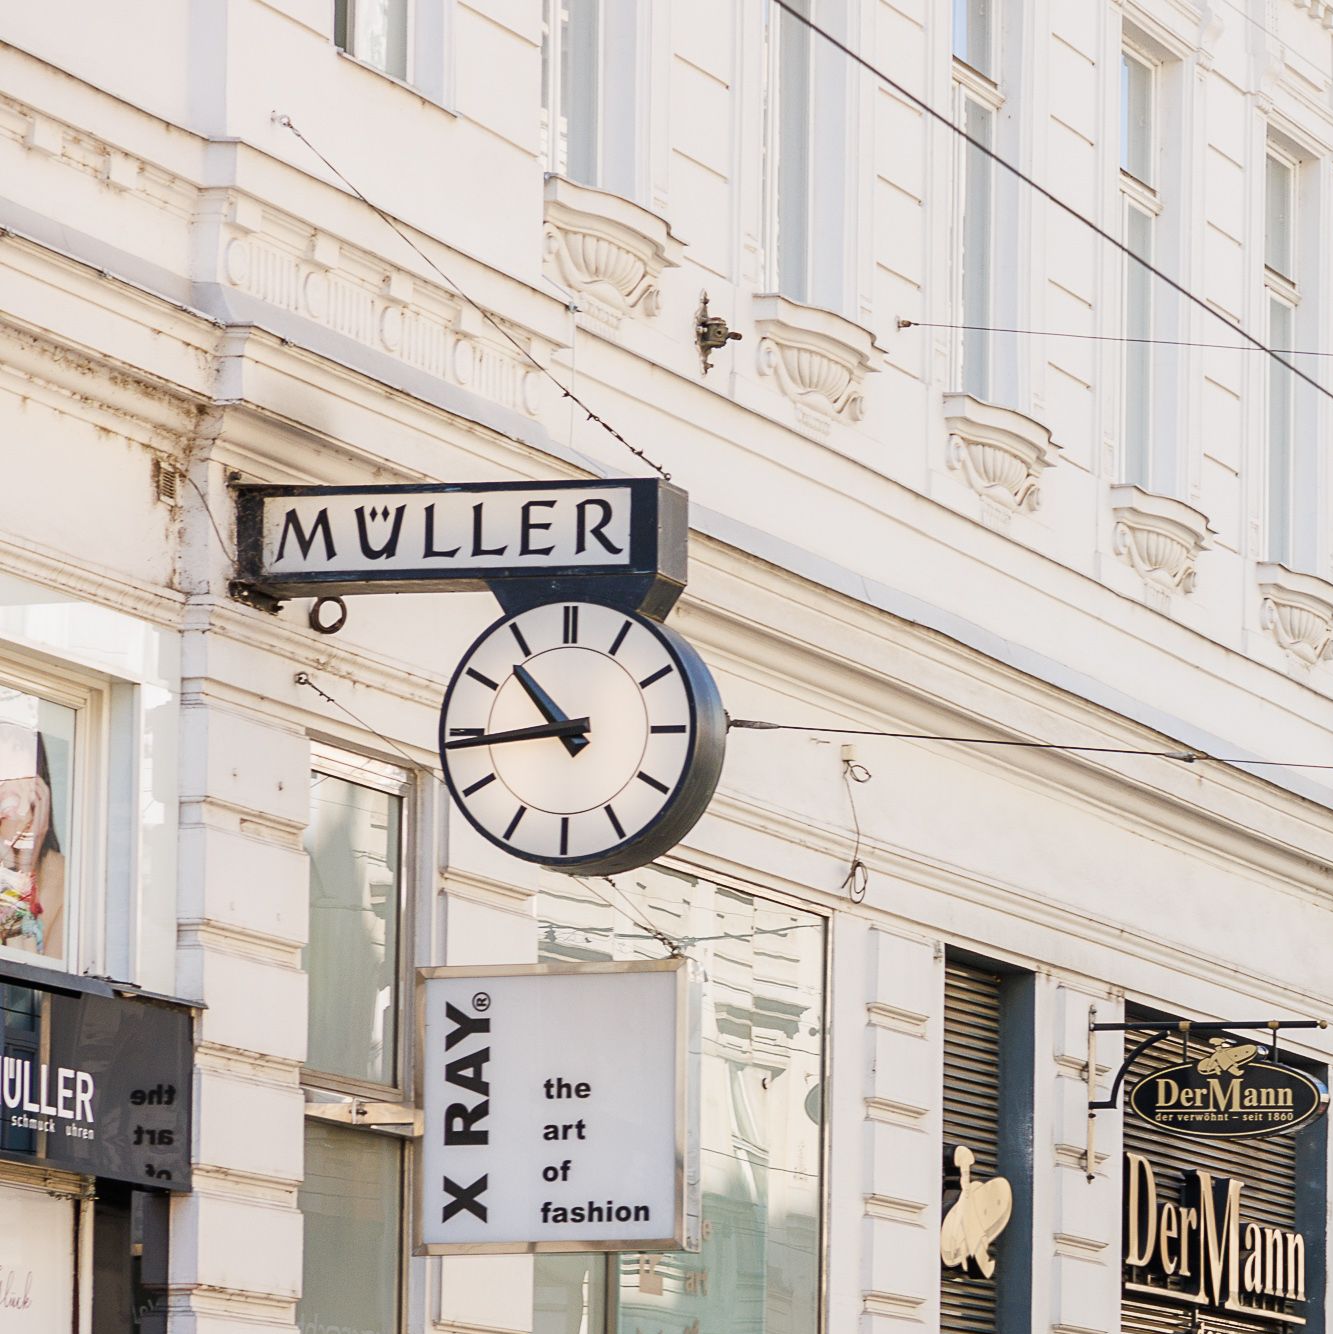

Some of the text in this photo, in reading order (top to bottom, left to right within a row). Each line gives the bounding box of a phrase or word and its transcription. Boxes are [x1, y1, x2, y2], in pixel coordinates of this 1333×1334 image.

[274, 498, 624, 564] MÜLLER
[0, 1055, 94, 1123] ÜLLER
[543, 1078, 591, 1100] the
[1155, 1077, 1294, 1112] DerMann
[11, 1113, 95, 1140] schmuck uhren
[542, 1119, 587, 1141] art
[1155, 1112, 1173, 1121] der
[1177, 1112, 1229, 1121] verwöhnt
[1242, 1112, 1263, 1121] seit
[1267, 1112, 1294, 1121] 1860
[542, 1159, 573, 1182] of
[442, 1172, 489, 1224] X
[540, 1200, 651, 1224] fashion
[1124, 1151, 1307, 1308] DerMann
